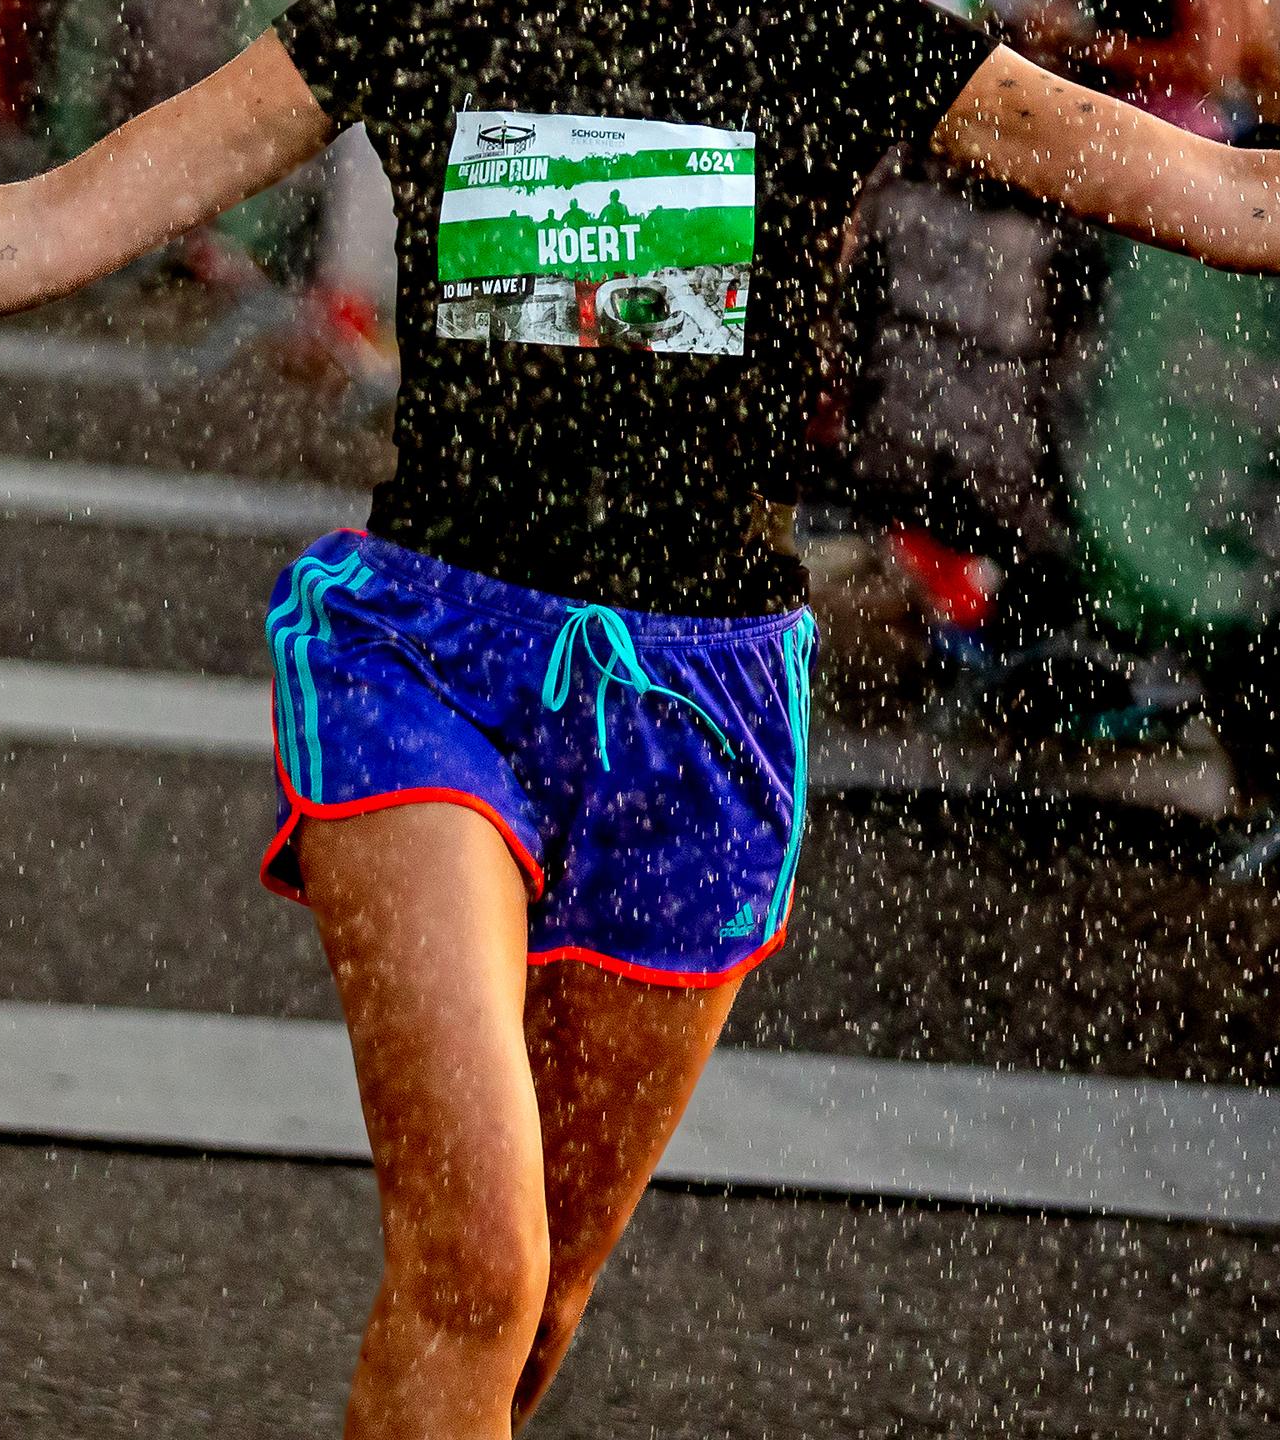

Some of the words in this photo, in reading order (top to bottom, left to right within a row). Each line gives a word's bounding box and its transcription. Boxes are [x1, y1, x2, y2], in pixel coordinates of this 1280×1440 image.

[571, 129, 626, 140] SCHOUTEN
[468, 160, 508, 185] HUIP
[508, 157, 549, 182] RUN
[686, 151, 734, 173] 4624
[538, 224, 641, 266] KOERT
[443, 284, 455, 299] 10
[482, 278, 518, 295] WAVE
